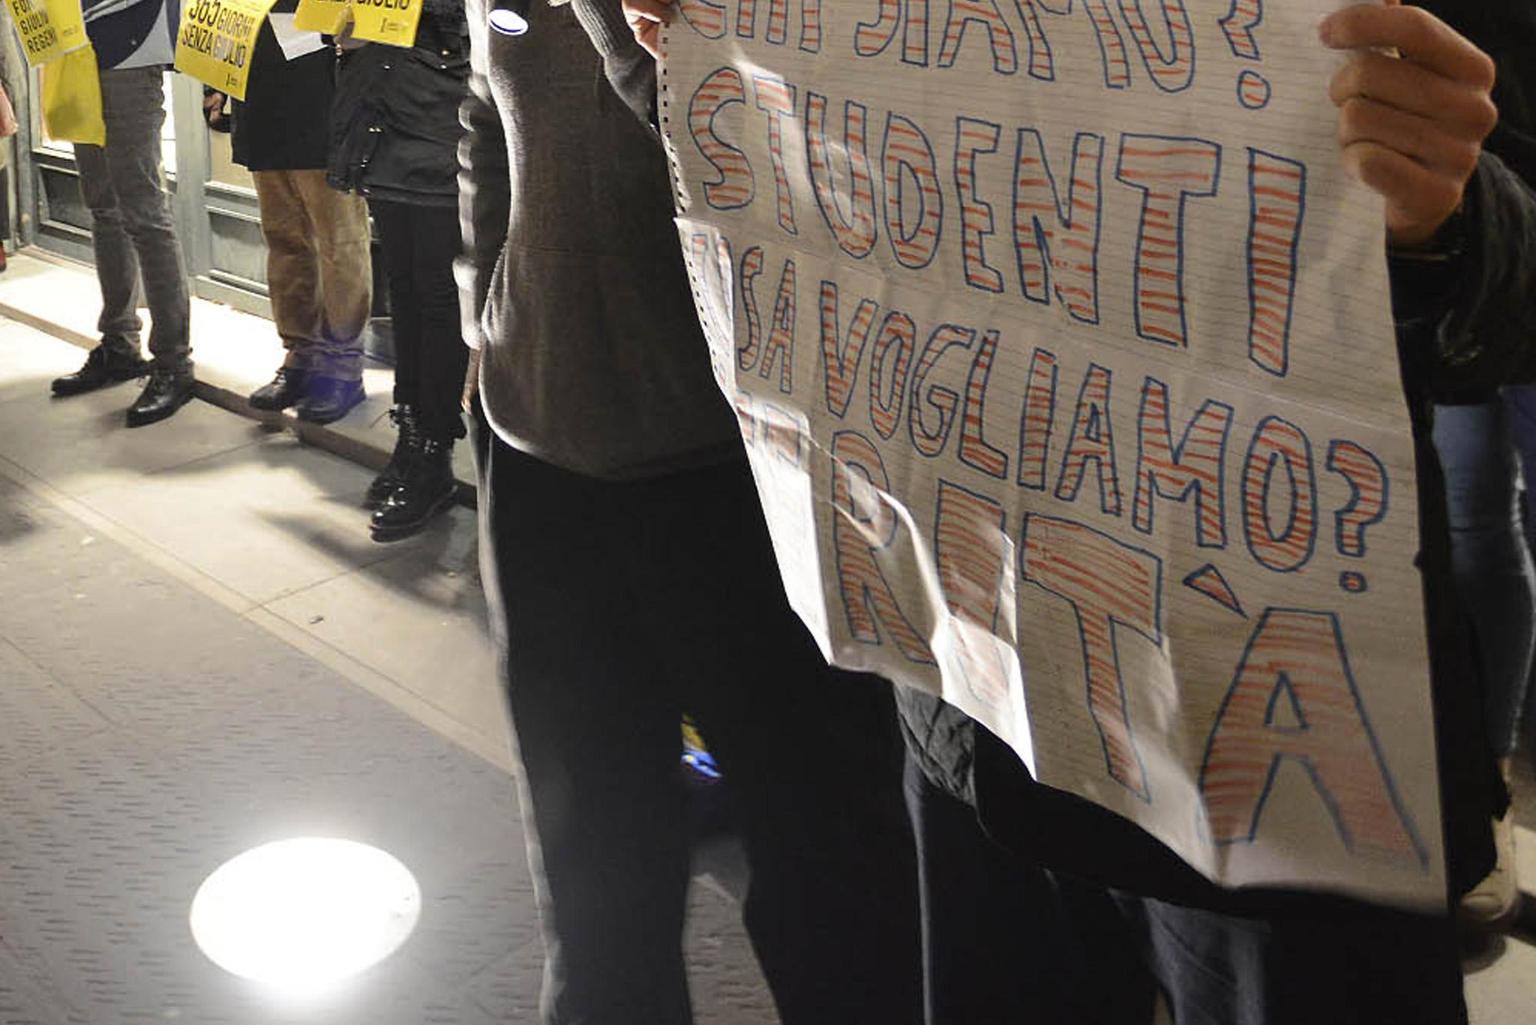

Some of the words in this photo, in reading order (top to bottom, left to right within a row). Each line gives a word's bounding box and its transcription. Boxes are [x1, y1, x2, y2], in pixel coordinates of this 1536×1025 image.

[182, 23, 214, 56] SENZA
[687, 66, 1308, 378] STUDENTI
[820, 279, 1390, 594] VOGLIAMO?
